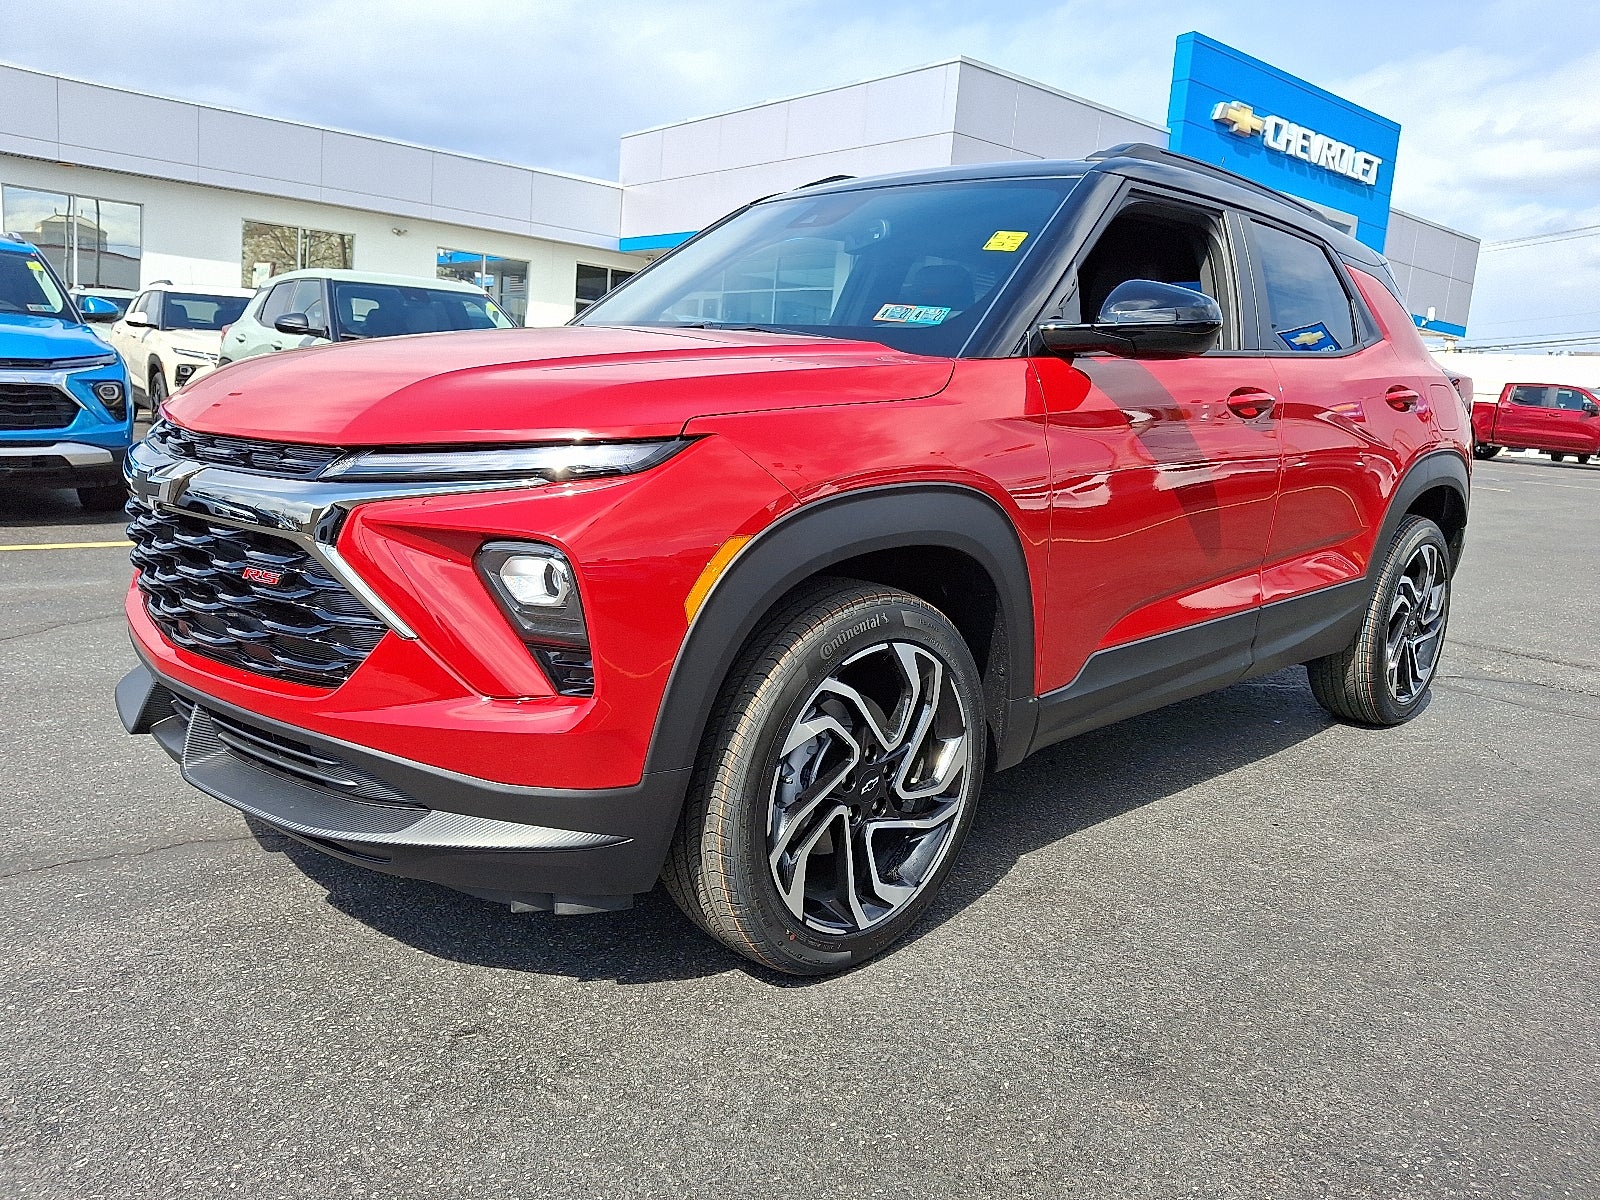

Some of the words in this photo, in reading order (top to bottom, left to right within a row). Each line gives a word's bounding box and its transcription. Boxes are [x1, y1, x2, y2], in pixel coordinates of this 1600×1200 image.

[1264, 115, 1382, 185] CHEVROLET
[242, 567, 281, 585] RS
[820, 613, 881, 660] Continental
